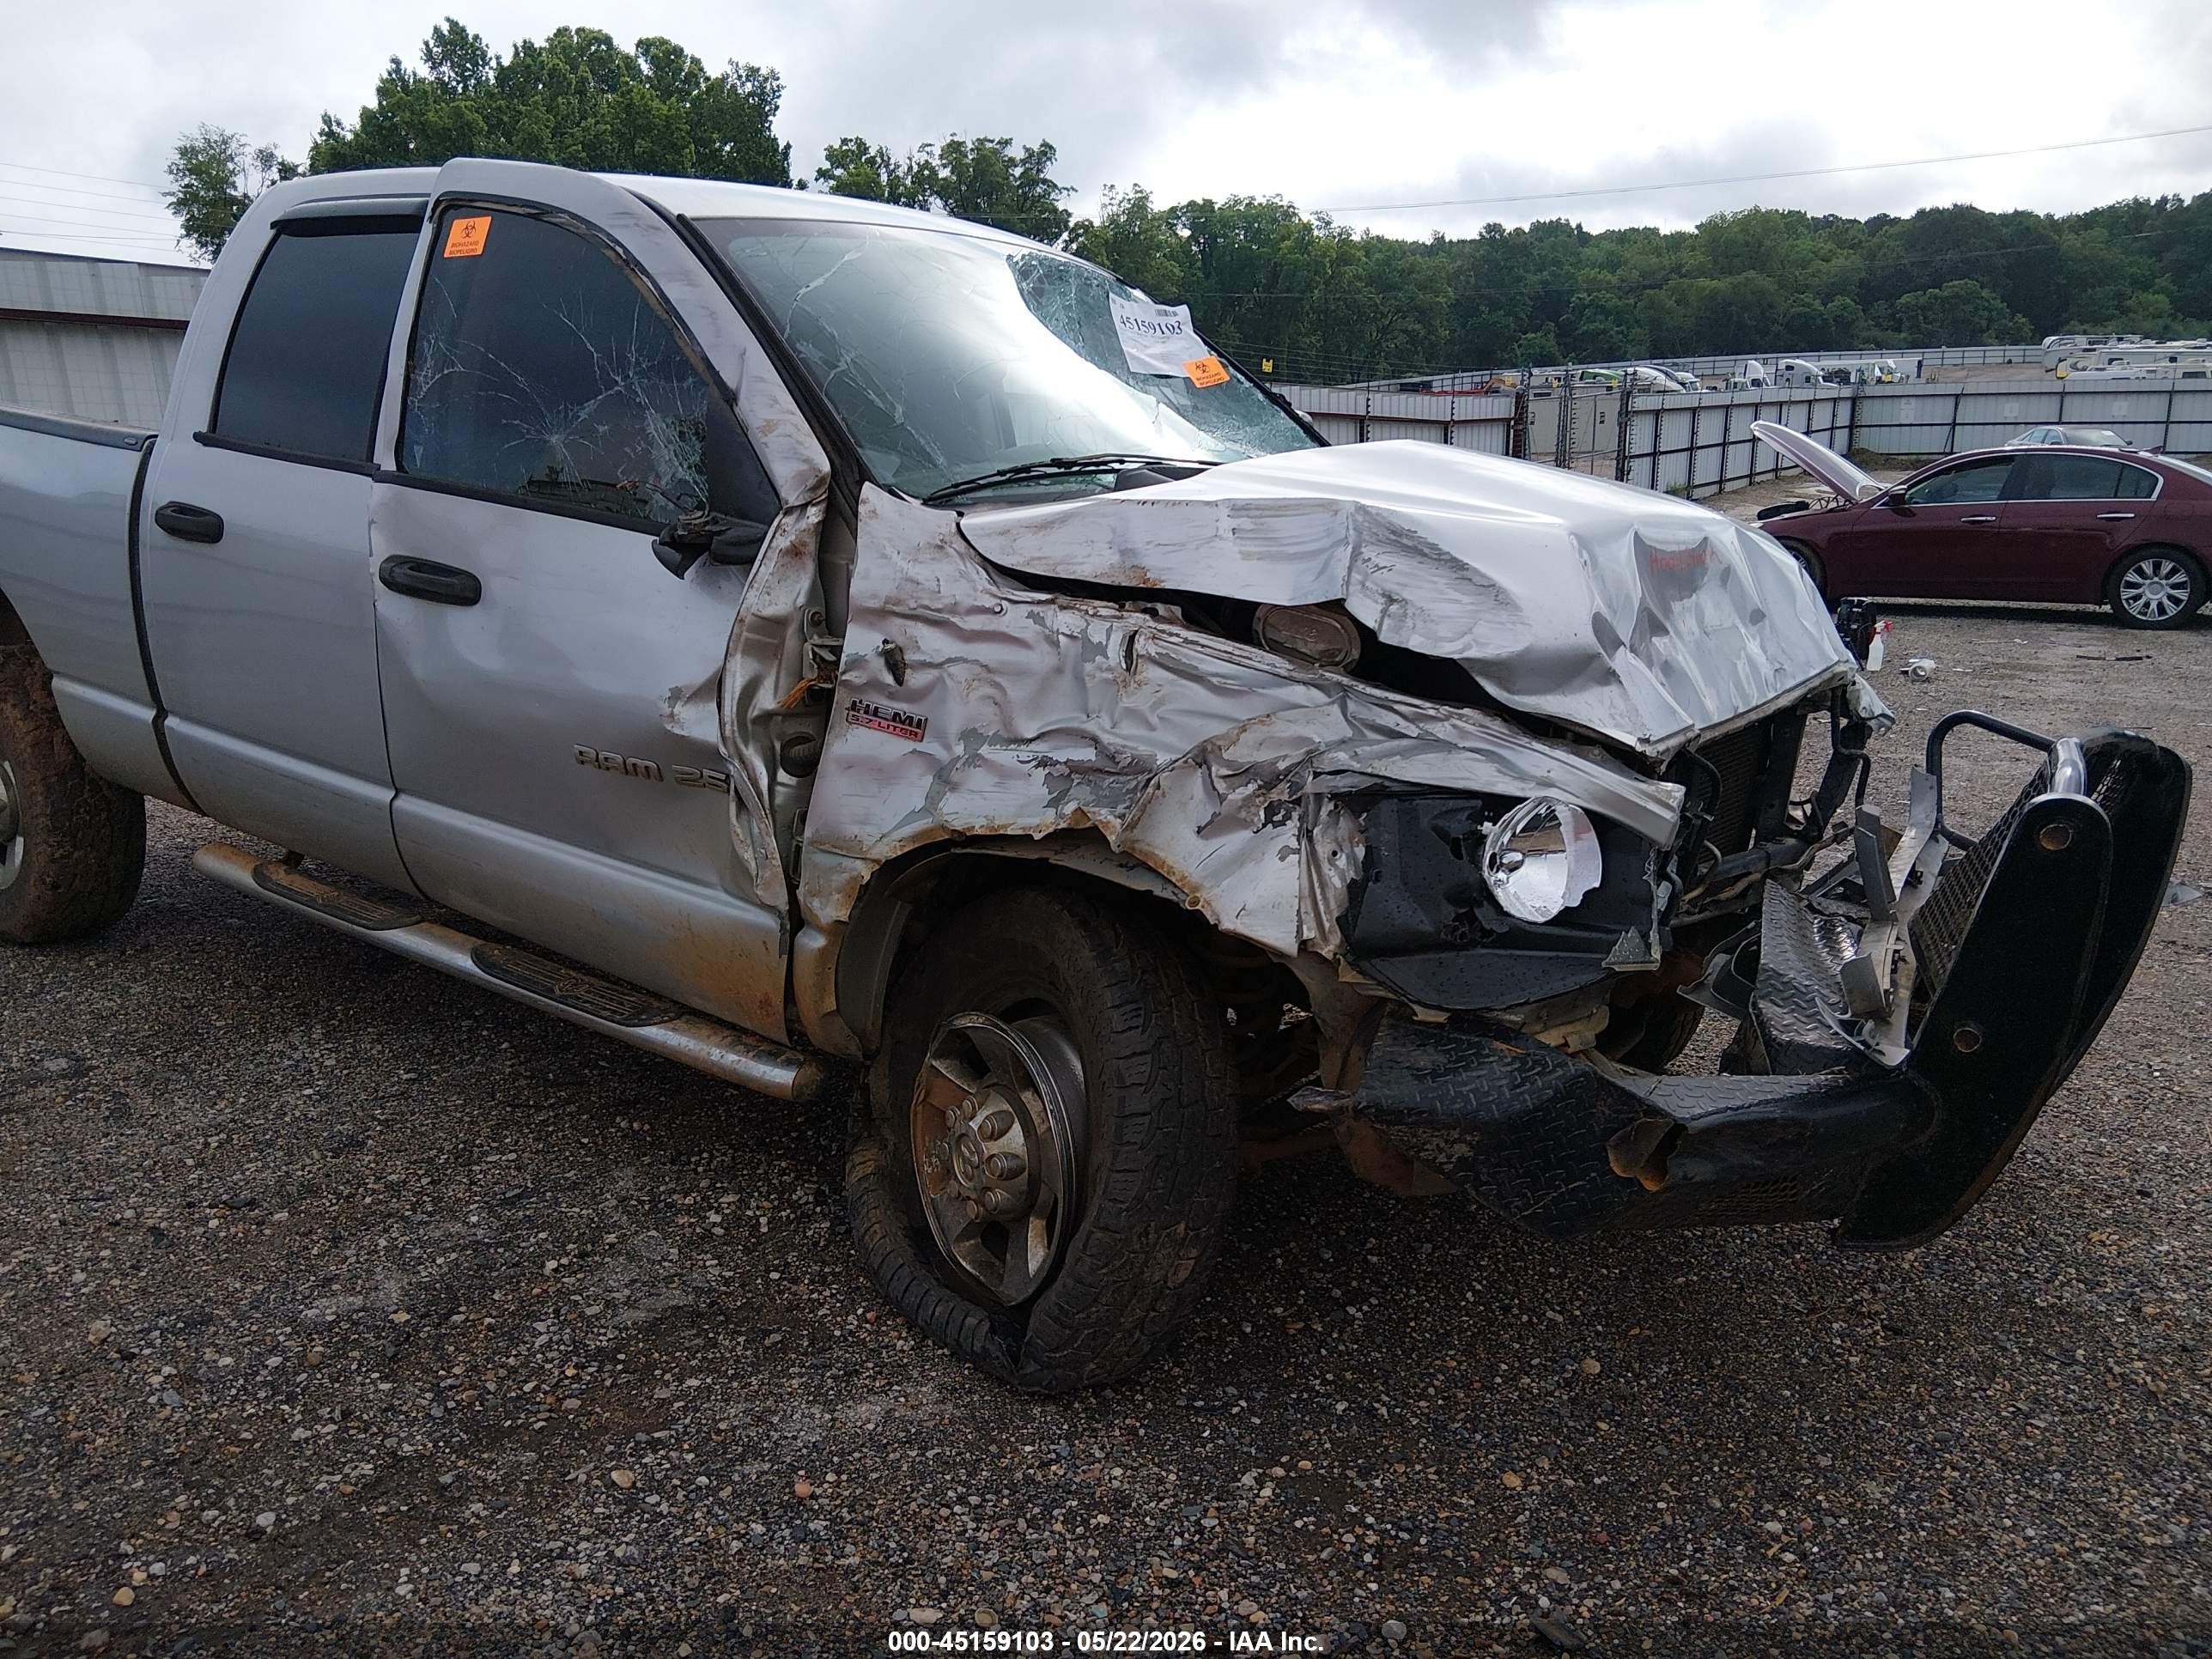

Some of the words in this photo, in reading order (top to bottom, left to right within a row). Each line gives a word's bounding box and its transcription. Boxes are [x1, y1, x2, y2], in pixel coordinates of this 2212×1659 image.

[1119, 313, 1183, 336] 45159103
[849, 697, 928, 730] HEMI
[850, 714, 877, 727] 5.7
[877, 720, 920, 739] LITER
[573, 743, 665, 782] RAM
